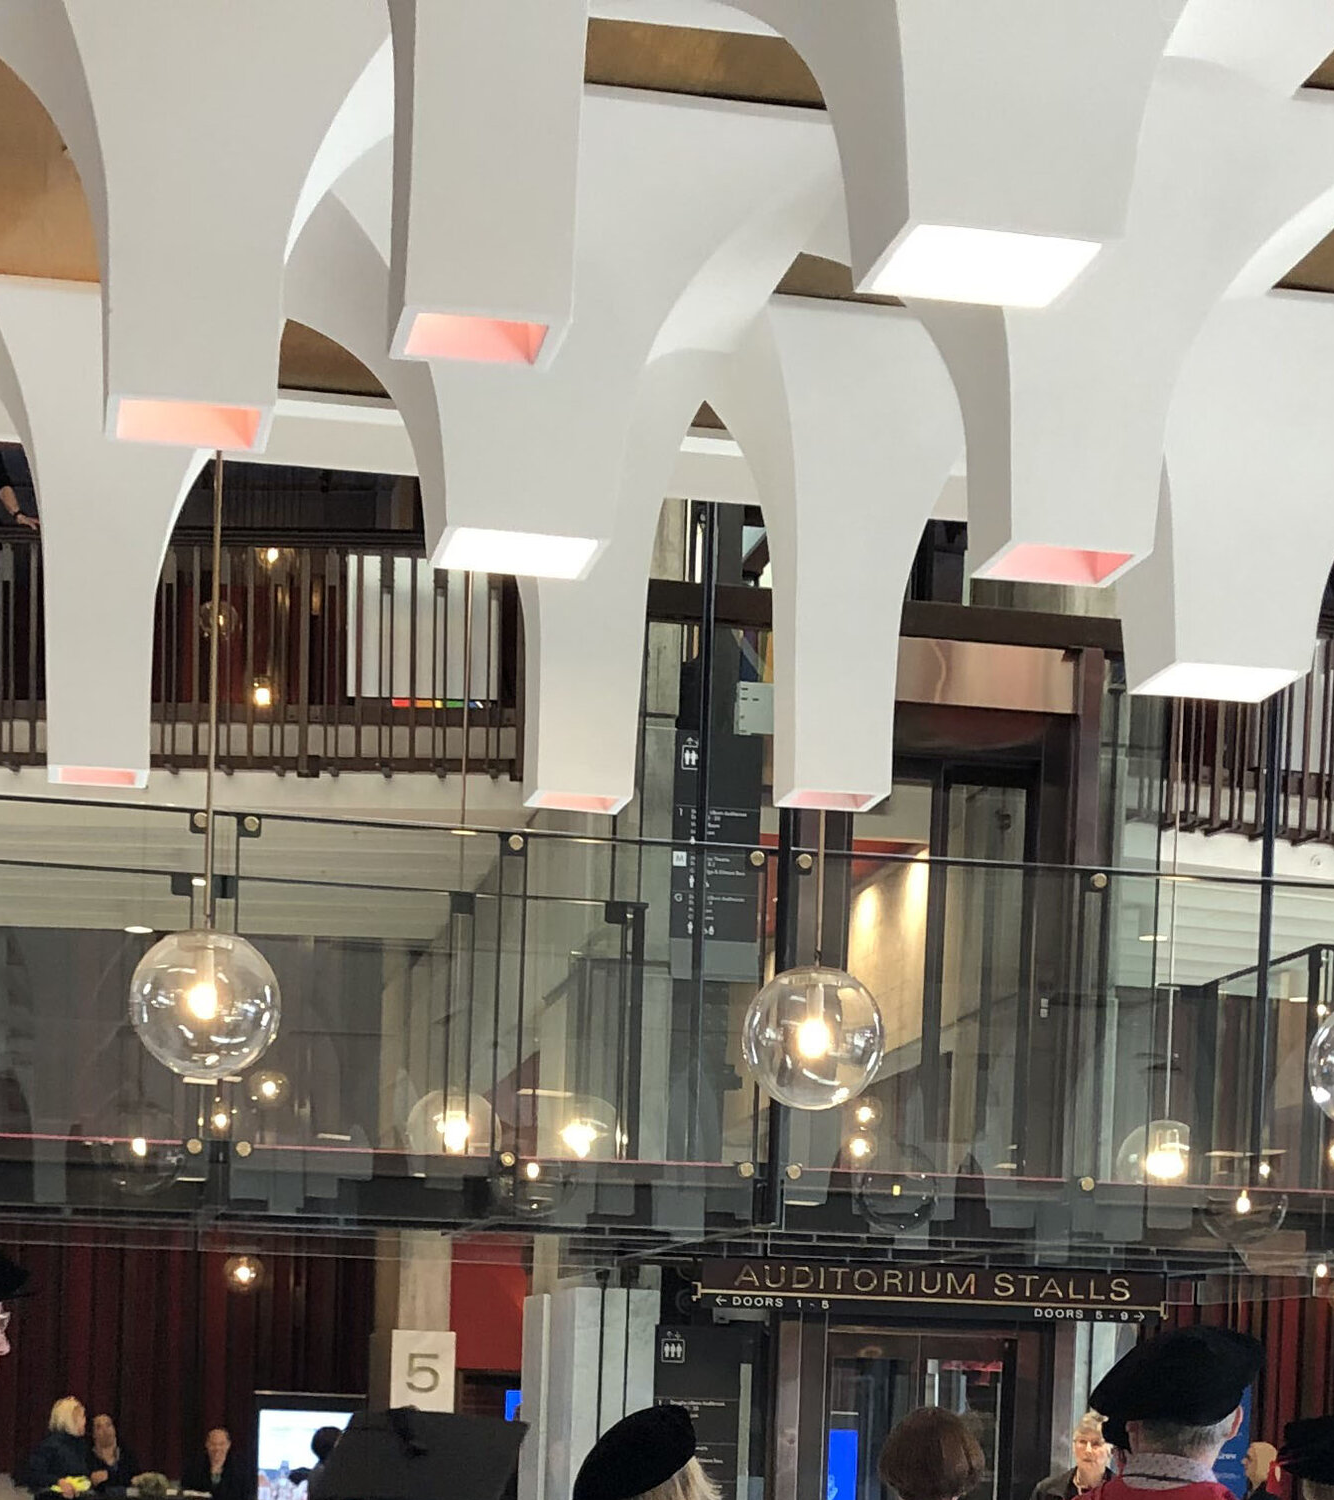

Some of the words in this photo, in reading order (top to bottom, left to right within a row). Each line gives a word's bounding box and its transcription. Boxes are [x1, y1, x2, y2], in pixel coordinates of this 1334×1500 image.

[734, 1264, 976, 1295] AUDITORIUM
[993, 1273, 1132, 1301] STALLS
[732, 1296, 784, 1307] DOORS
[797, 1299, 802, 1308] 1
[1034, 1308, 1084, 1319] DOORS
[406, 1353, 440, 1393] 5
